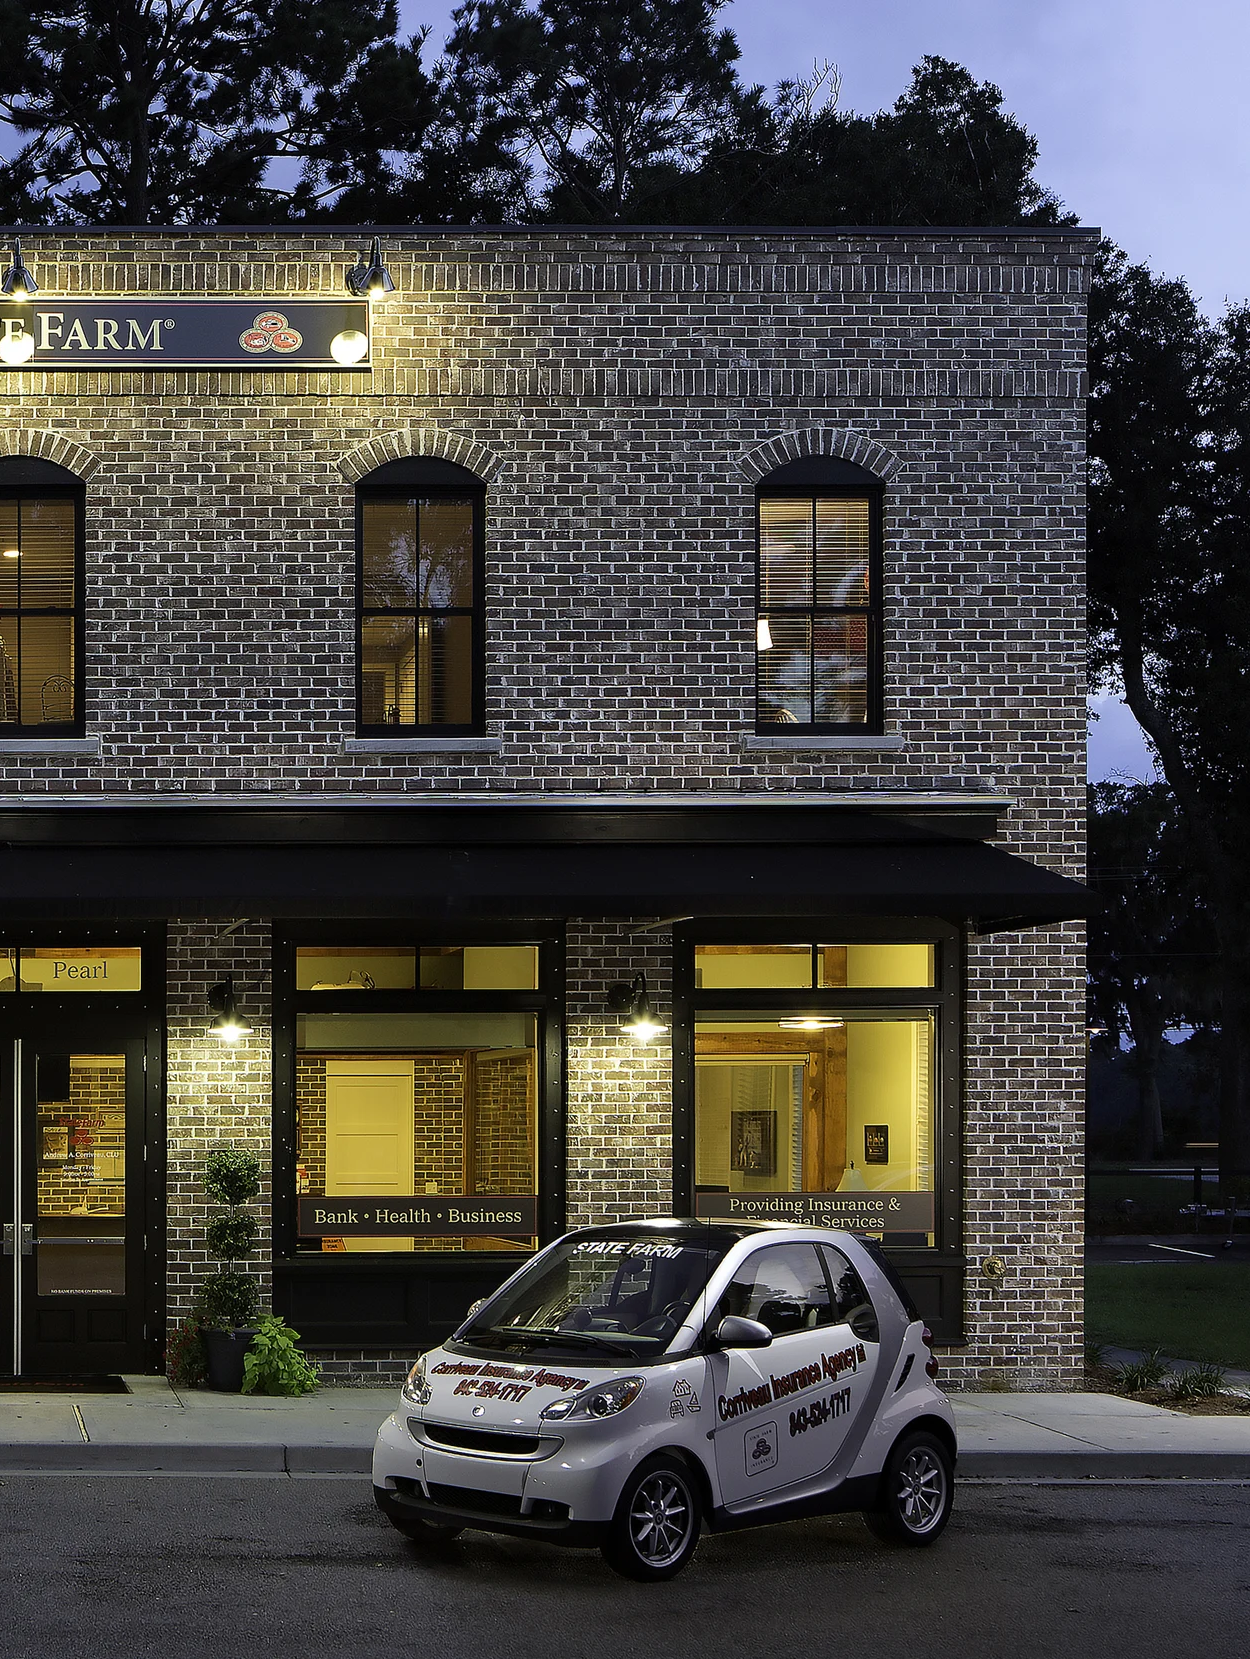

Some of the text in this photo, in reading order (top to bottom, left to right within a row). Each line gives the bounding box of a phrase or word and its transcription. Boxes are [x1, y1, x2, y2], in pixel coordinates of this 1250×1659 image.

[52, 960, 109, 980] Pearl
[729, 1196, 902, 1215] Providing Insurance &
[314, 1207, 523, 1225] Bank Health Business
[820, 1214, 886, 1228] Services
[573, 1242, 684, 1259] STATE FARM
[529, 1368, 579, 1392] Agency
[717, 1345, 858, 1422] Corriveau Insurance Agency
[788, 1386, 852, 1438] 843-524-1717
